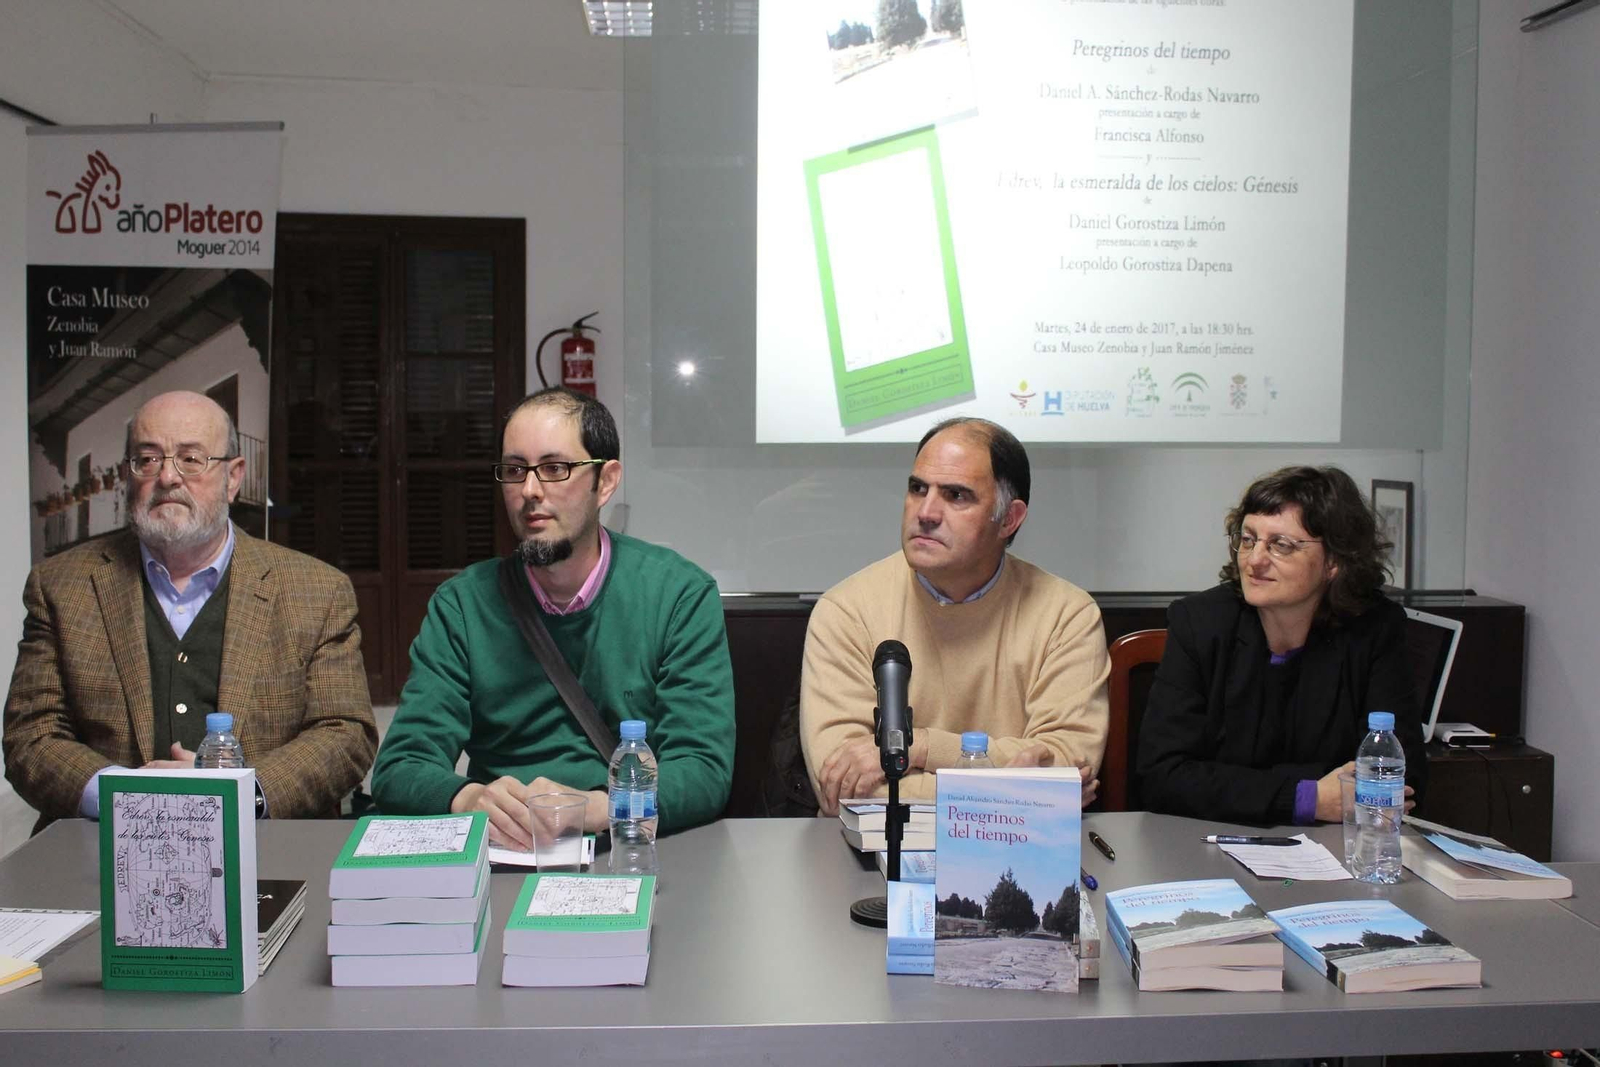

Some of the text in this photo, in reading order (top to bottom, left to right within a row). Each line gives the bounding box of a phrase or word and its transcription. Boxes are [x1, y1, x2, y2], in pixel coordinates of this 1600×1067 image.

[1072, 39, 1231, 65] Peregrinos del tiempo
[1039, 82, 1260, 104] Daniel A. Sánchez-Rodas Navarro
[1098, 107, 1153, 120] presentación
[1163, 110, 1188, 121] cargo
[1190, 108, 1201, 119] de
[1094, 127, 1205, 144] Francisca Alfonso
[1053, 171, 1065, 190] la
[1070, 172, 1141, 191] esmeralda
[1146, 173, 1163, 191] de
[1168, 174, 1189, 192] los
[1193, 174, 1238, 193] cielos:
[1243, 174, 1299, 194] Génesis
[1069, 214, 1226, 232] Daniel Gorostiza Limón
[1096, 236, 1151, 249] presentación
[1160, 239, 1186, 251] cargo
[1188, 237, 1198, 249] de
[1060, 256, 1233, 276] Leopoldo Gorostiza Dapena
[47, 286, 150, 309] Casa Museo
[47, 315, 99, 334] Zenobia
[1034, 321, 1071, 336] Martes,
[1074, 322, 1087, 335] 24
[1090, 322, 1102, 335] de
[1105, 324, 1133, 335] enero
[1136, 322, 1148, 335] de
[1151, 322, 1179, 337] 2017,
[1181, 325, 1188, 335] a
[1190, 323, 1203, 335] las
[1207, 323, 1233, 335] 18:30
[48, 340, 137, 359] y Juan Ramón
[1033, 341, 1254, 357] Casa Museo Zenobia y Juan Ramón Jiménez
[1077, 401, 1111, 412] HUELVA
[167, 811, 216, 823] esmeralda
[948, 805, 1025, 825] Peregrinos
[117, 828, 129, 839] de
[948, 822, 1028, 846] del tiempo
[116, 853, 126, 885] EDREV
[113, 966, 145, 976] DANIEL
[149, 966, 199, 977] GOROSTIZA
